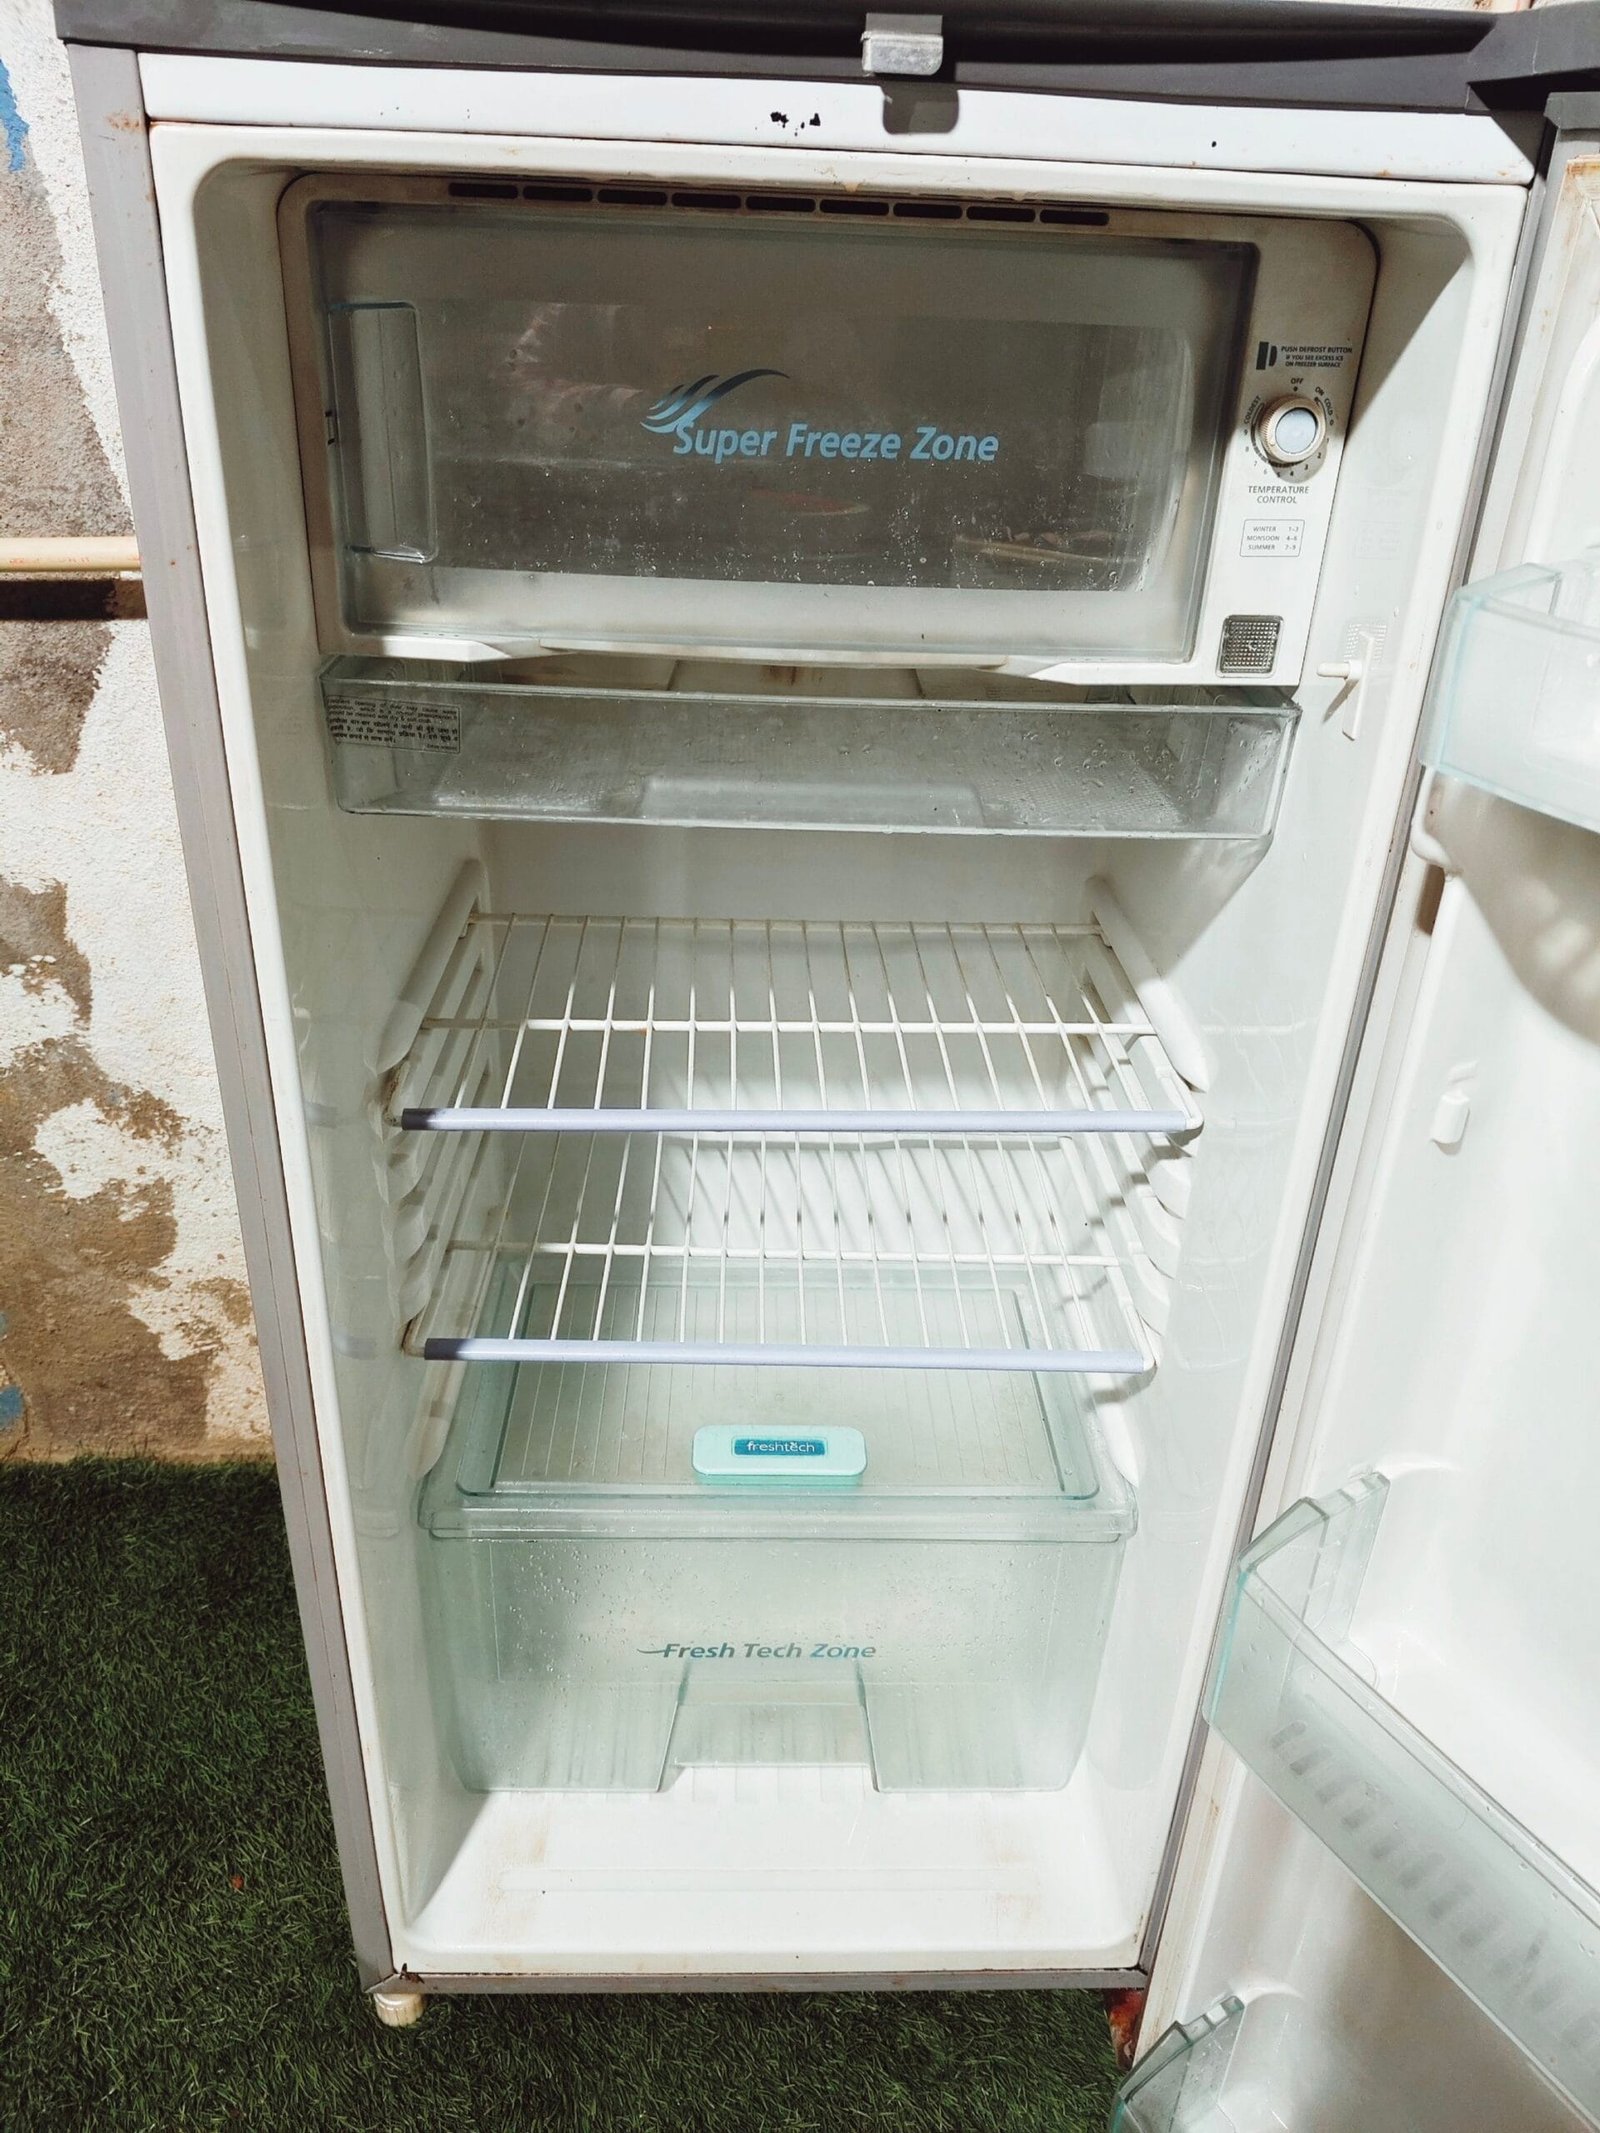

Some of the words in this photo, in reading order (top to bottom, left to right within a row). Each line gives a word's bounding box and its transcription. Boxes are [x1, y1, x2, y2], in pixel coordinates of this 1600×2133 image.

[1327, 346, 1353, 354] BUTTON
[1315, 386, 1325, 396] ON
[1244, 395, 1261, 424] COLDEST
[1324, 398, 1334, 416] COLD
[673, 421, 778, 465] Super
[784, 423, 902, 460] Freeze
[909, 426, 1000, 462] Zone
[1248, 485, 1310, 494] TEMPERATURE
[1256, 495, 1298, 504] CONTROL
[746, 1440, 815, 1453] freshtech
[662, 1642, 736, 1659] Fresh
[743, 1642, 803, 1659] Tech
[809, 1643, 878, 1659] Zone
